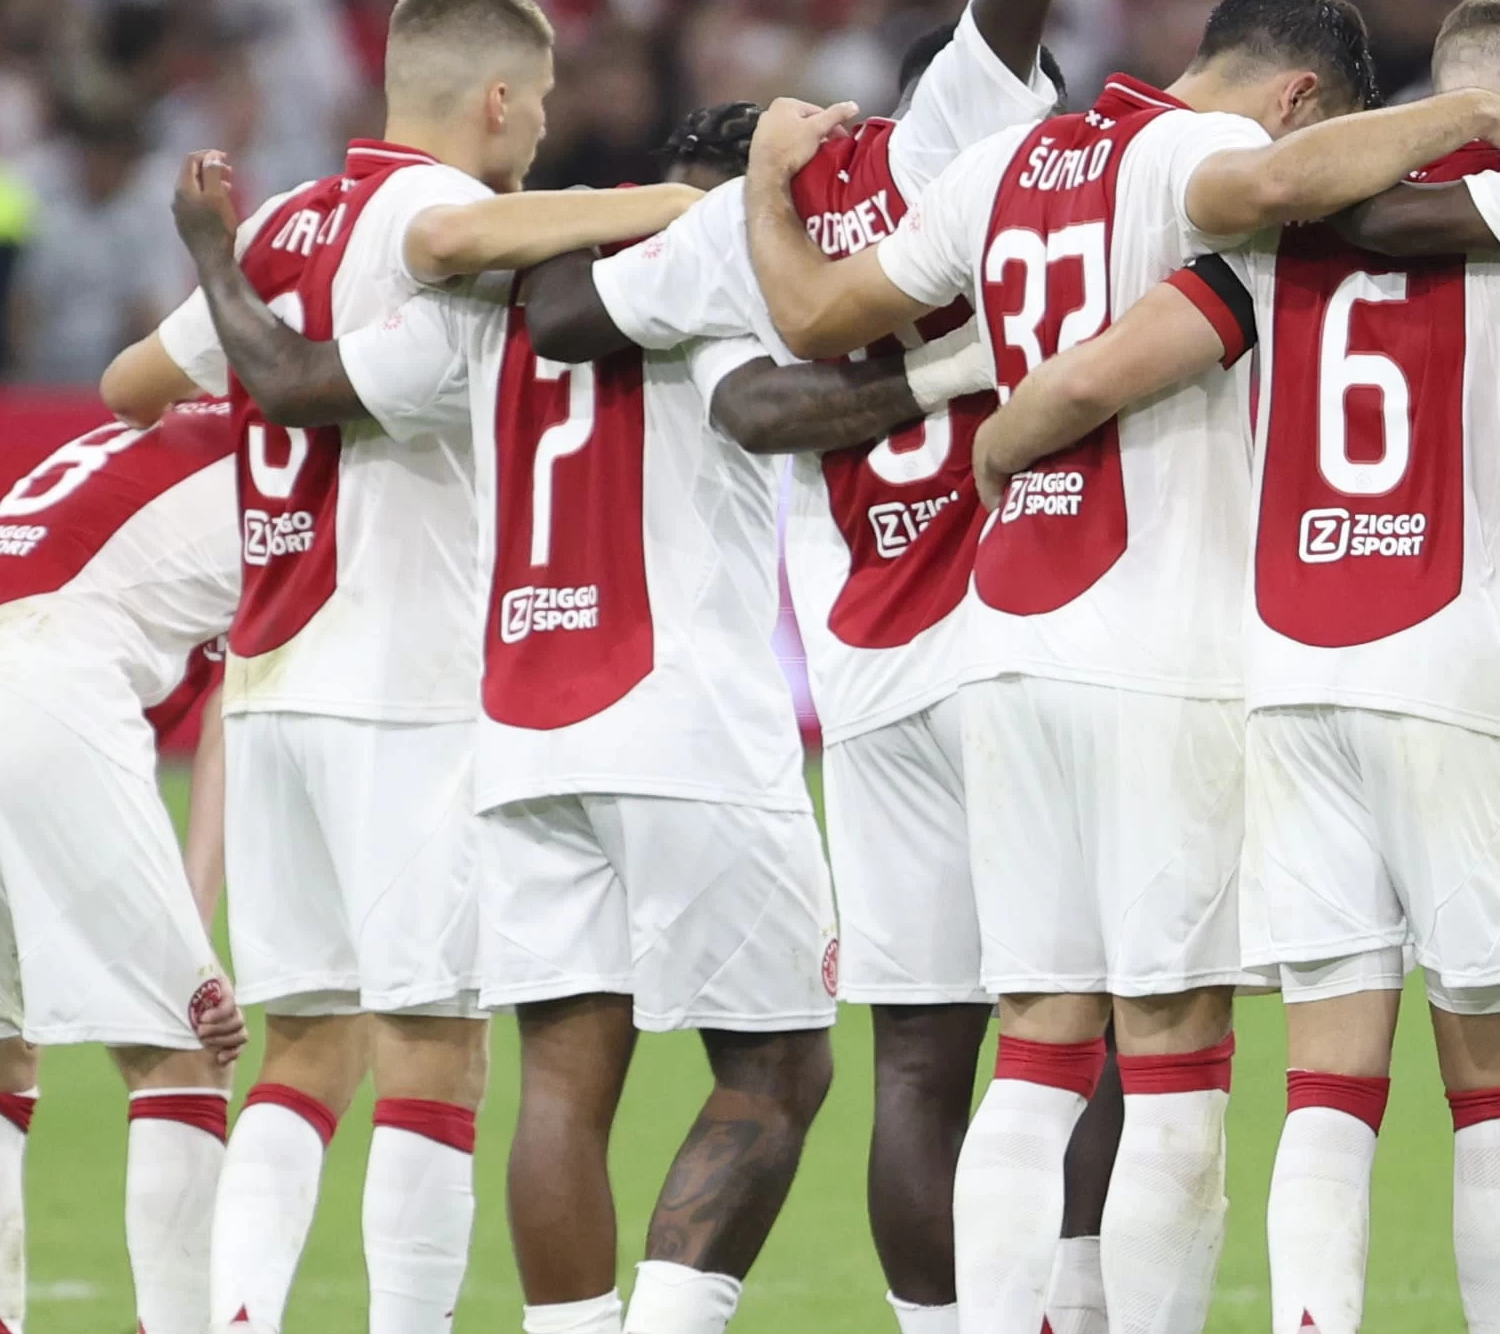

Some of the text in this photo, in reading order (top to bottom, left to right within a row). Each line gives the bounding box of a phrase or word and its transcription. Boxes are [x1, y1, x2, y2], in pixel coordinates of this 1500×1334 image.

[1317, 270, 1412, 497] 6
[530, 355, 596, 567] 7
[1028, 471, 1084, 493] ZIGGO
[1024, 494, 1082, 516] SPORT
[1353, 513, 1426, 536] ZIGGO
[1350, 535, 1424, 556] SPORT
[533, 584, 597, 610] ZIGGO
[532, 606, 598, 632] SPORT
